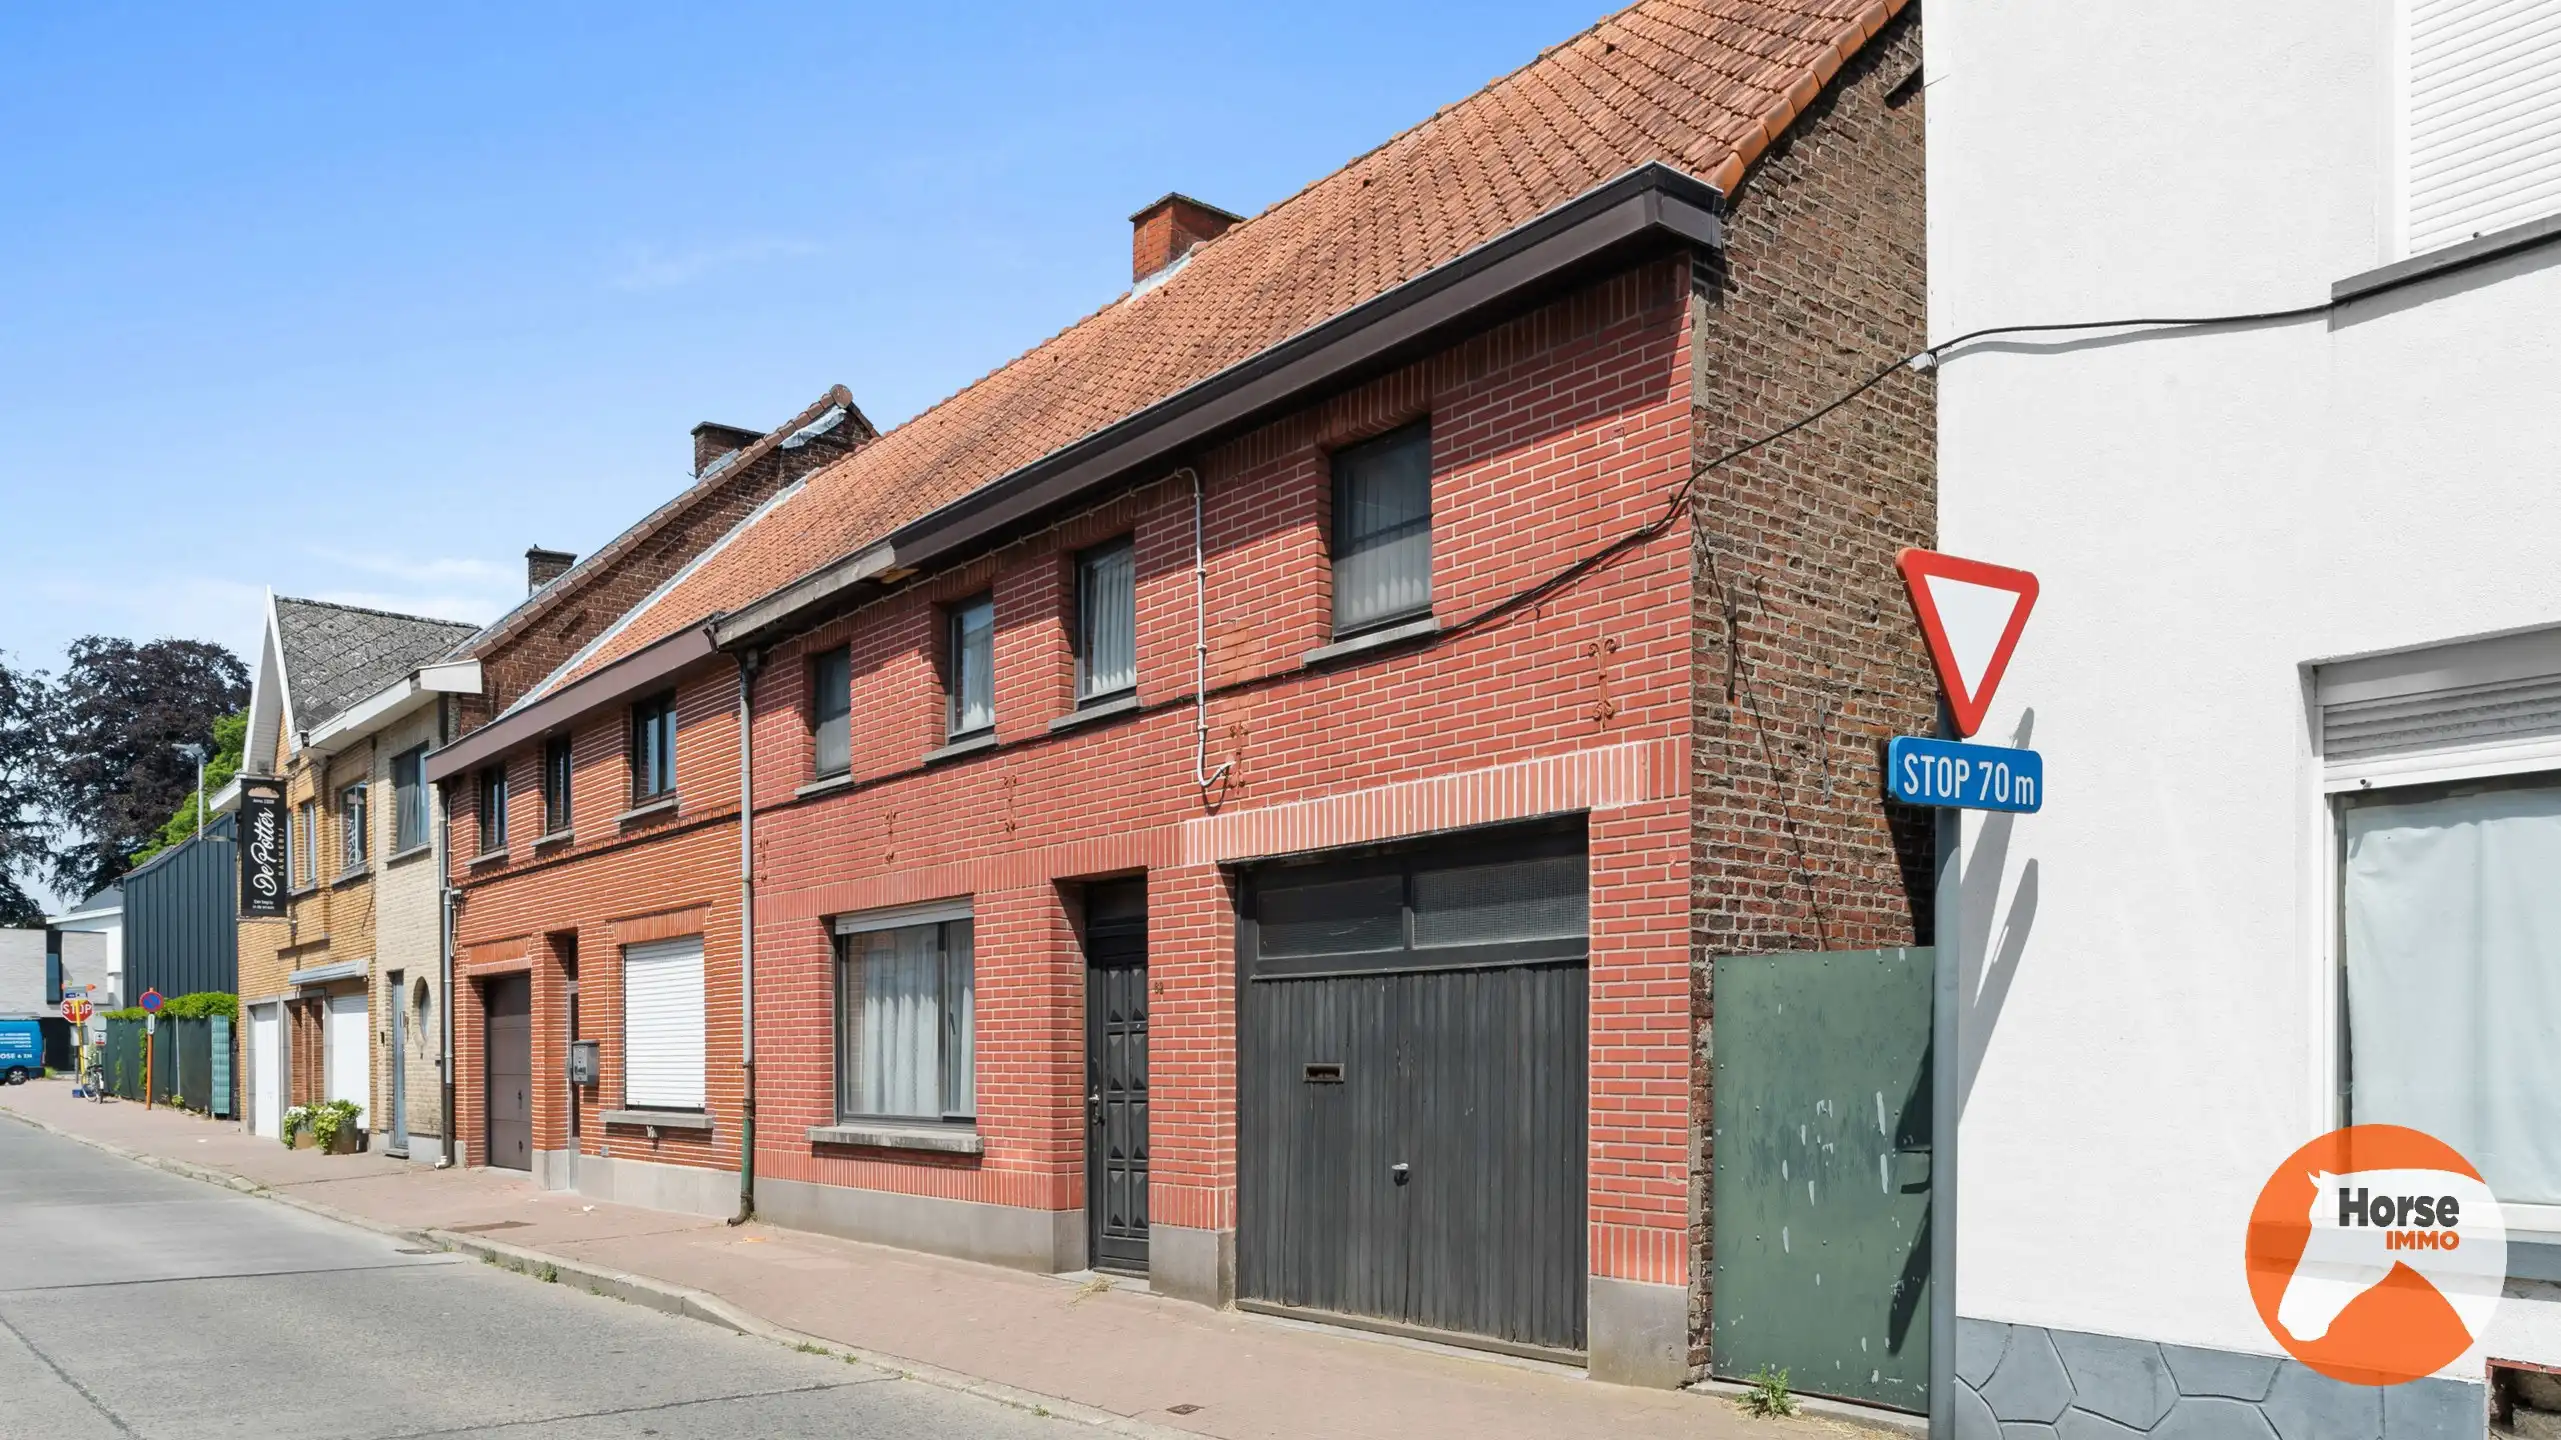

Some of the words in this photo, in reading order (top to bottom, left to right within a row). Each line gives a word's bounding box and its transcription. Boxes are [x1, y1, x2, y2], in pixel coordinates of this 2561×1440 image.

[1903, 752, 1970, 799] STOP
[1978, 761, 2010, 803] 70
[2014, 775, 2034, 806] m
[250, 807, 277, 865] Potter
[277, 827, 285, 876] BAKKERIJ
[63, 1003, 92, 1014] STOP
